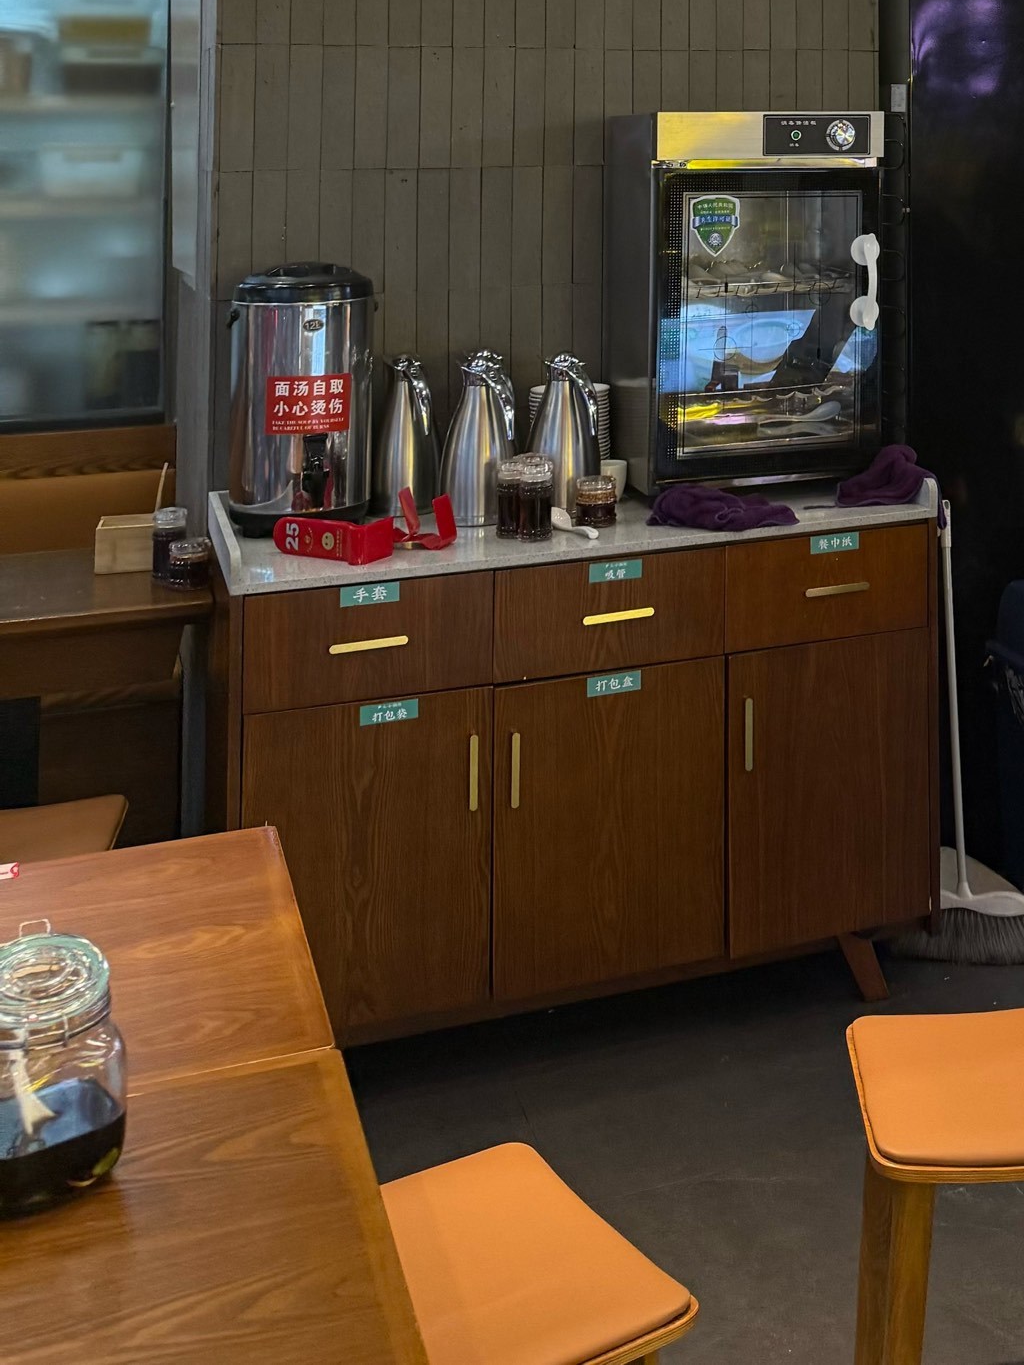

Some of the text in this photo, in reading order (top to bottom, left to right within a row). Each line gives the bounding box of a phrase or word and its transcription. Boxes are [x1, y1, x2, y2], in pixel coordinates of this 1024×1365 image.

[274, 378, 344, 397] 面汤自取
[273, 398, 344, 416] 小心烫伤
[285, 522, 300, 552] 25
[604, 569, 626, 580] 吸管
[353, 585, 388, 603] 手套
[595, 676, 634, 692] 打包盒
[371, 708, 408, 723] 打包袋
